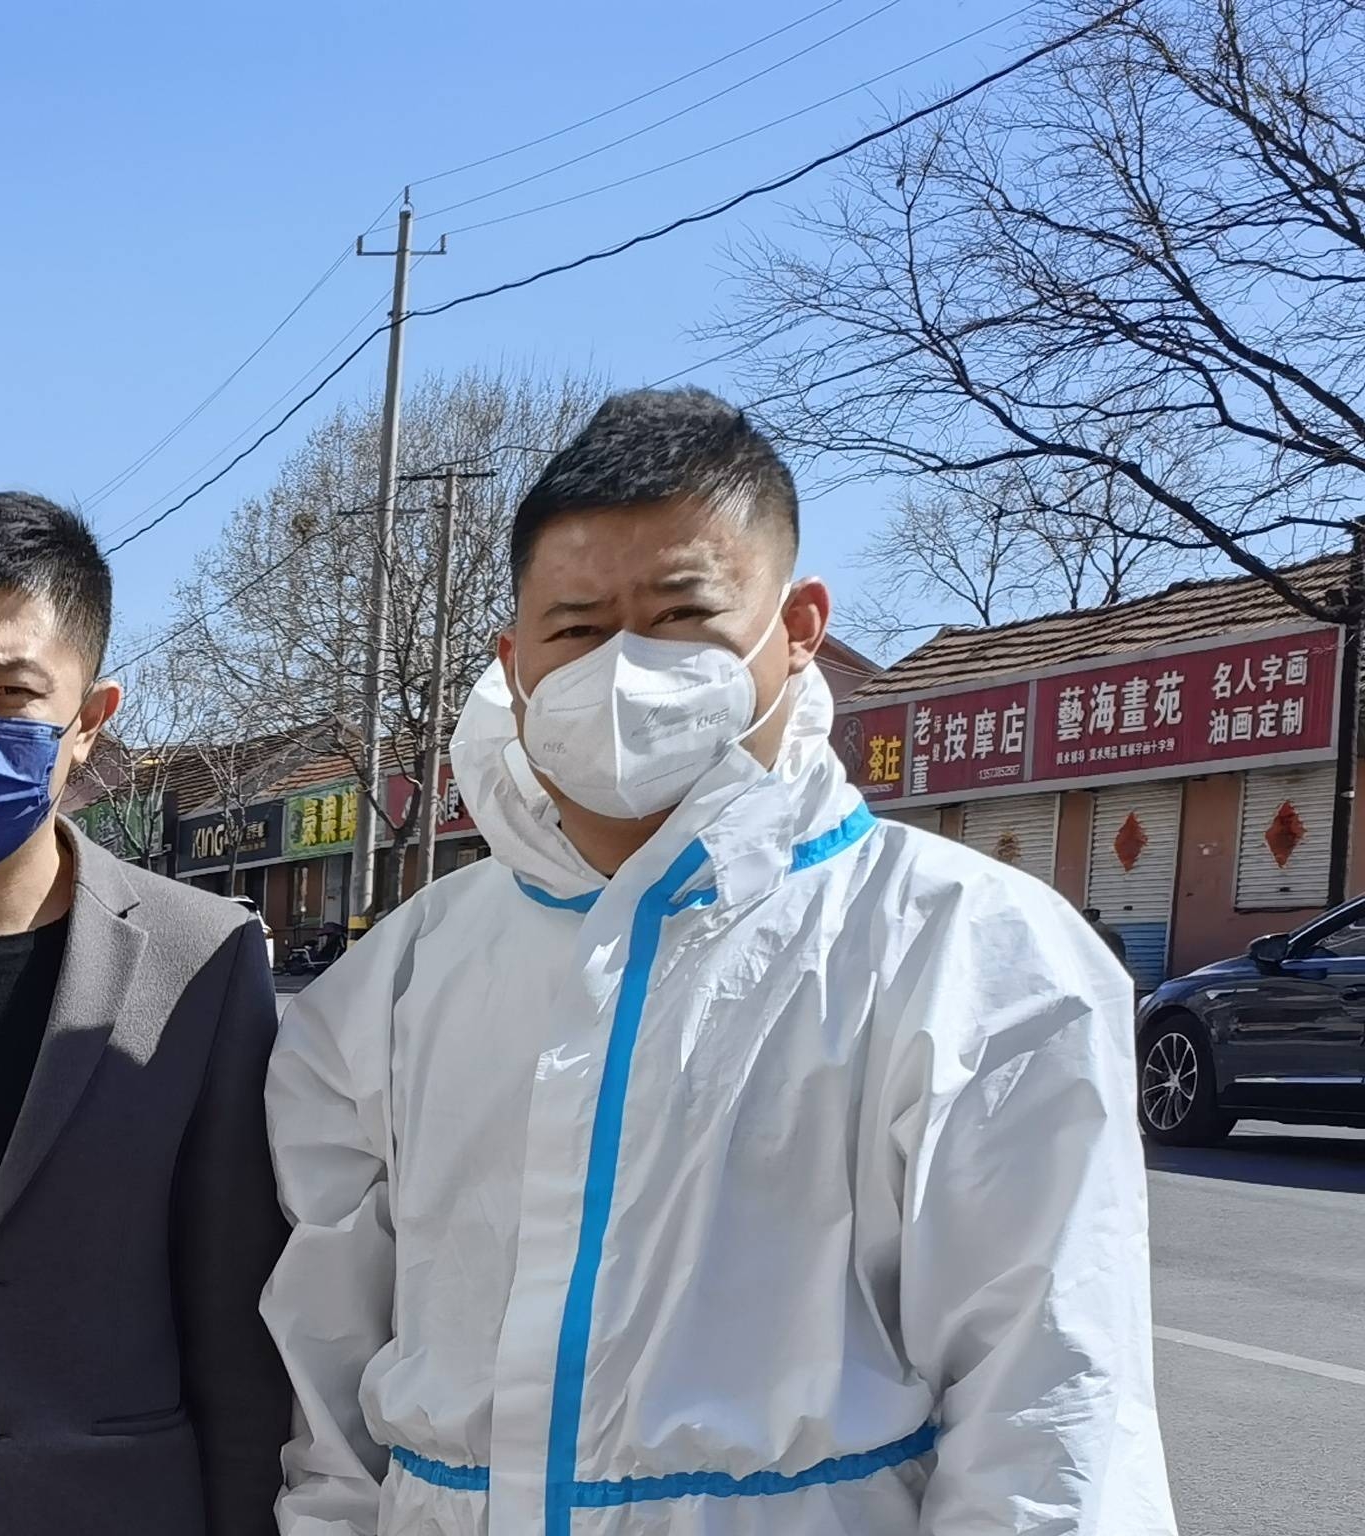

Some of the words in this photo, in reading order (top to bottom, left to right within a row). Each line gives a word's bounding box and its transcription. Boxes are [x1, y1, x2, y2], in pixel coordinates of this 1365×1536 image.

[1212, 649, 1309, 700] 名人字画
[1057, 670, 1185, 742] 藝海畫苑
[1208, 697, 1304, 745] 油画定制
[943, 701, 1026, 764] 按摩店
[868, 735, 902, 782] 茶庄
